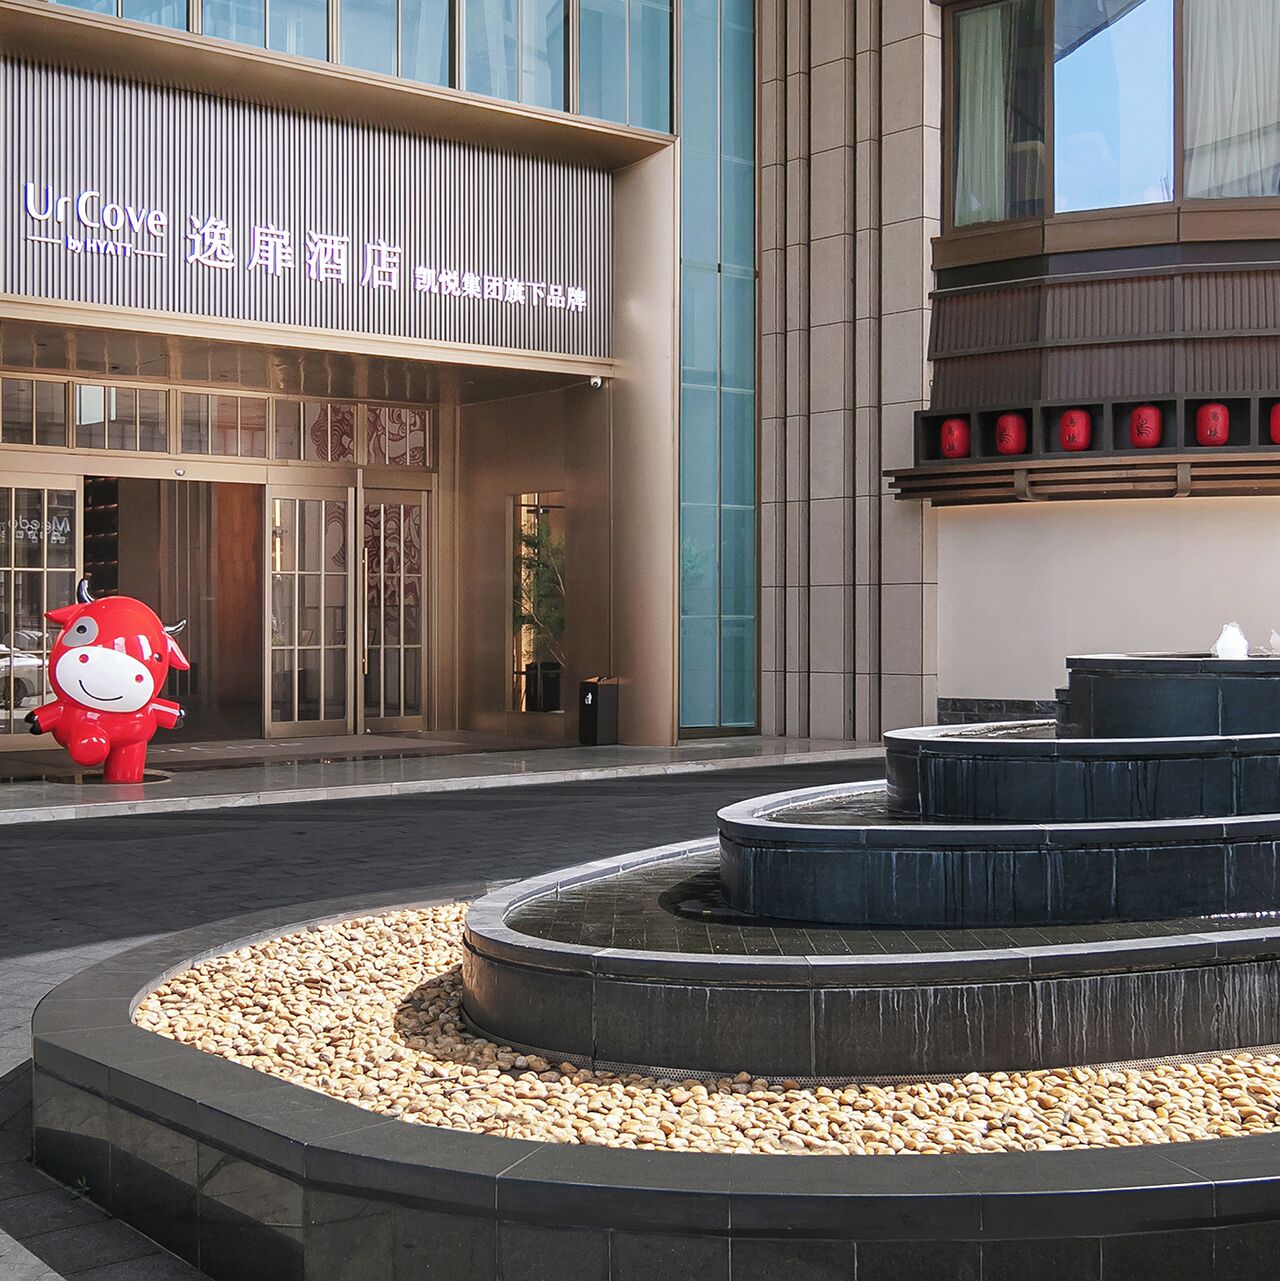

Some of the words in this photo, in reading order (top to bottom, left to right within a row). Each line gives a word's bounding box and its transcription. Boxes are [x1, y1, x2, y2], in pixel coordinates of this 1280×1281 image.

[24, 181, 167, 238] UrCove
[66, 234, 84, 254] by
[85, 238, 133, 258] HYATT
[185, 214, 402, 291] 逸扉酒店
[413, 265, 588, 313] 凯悦集团旗下品牌
